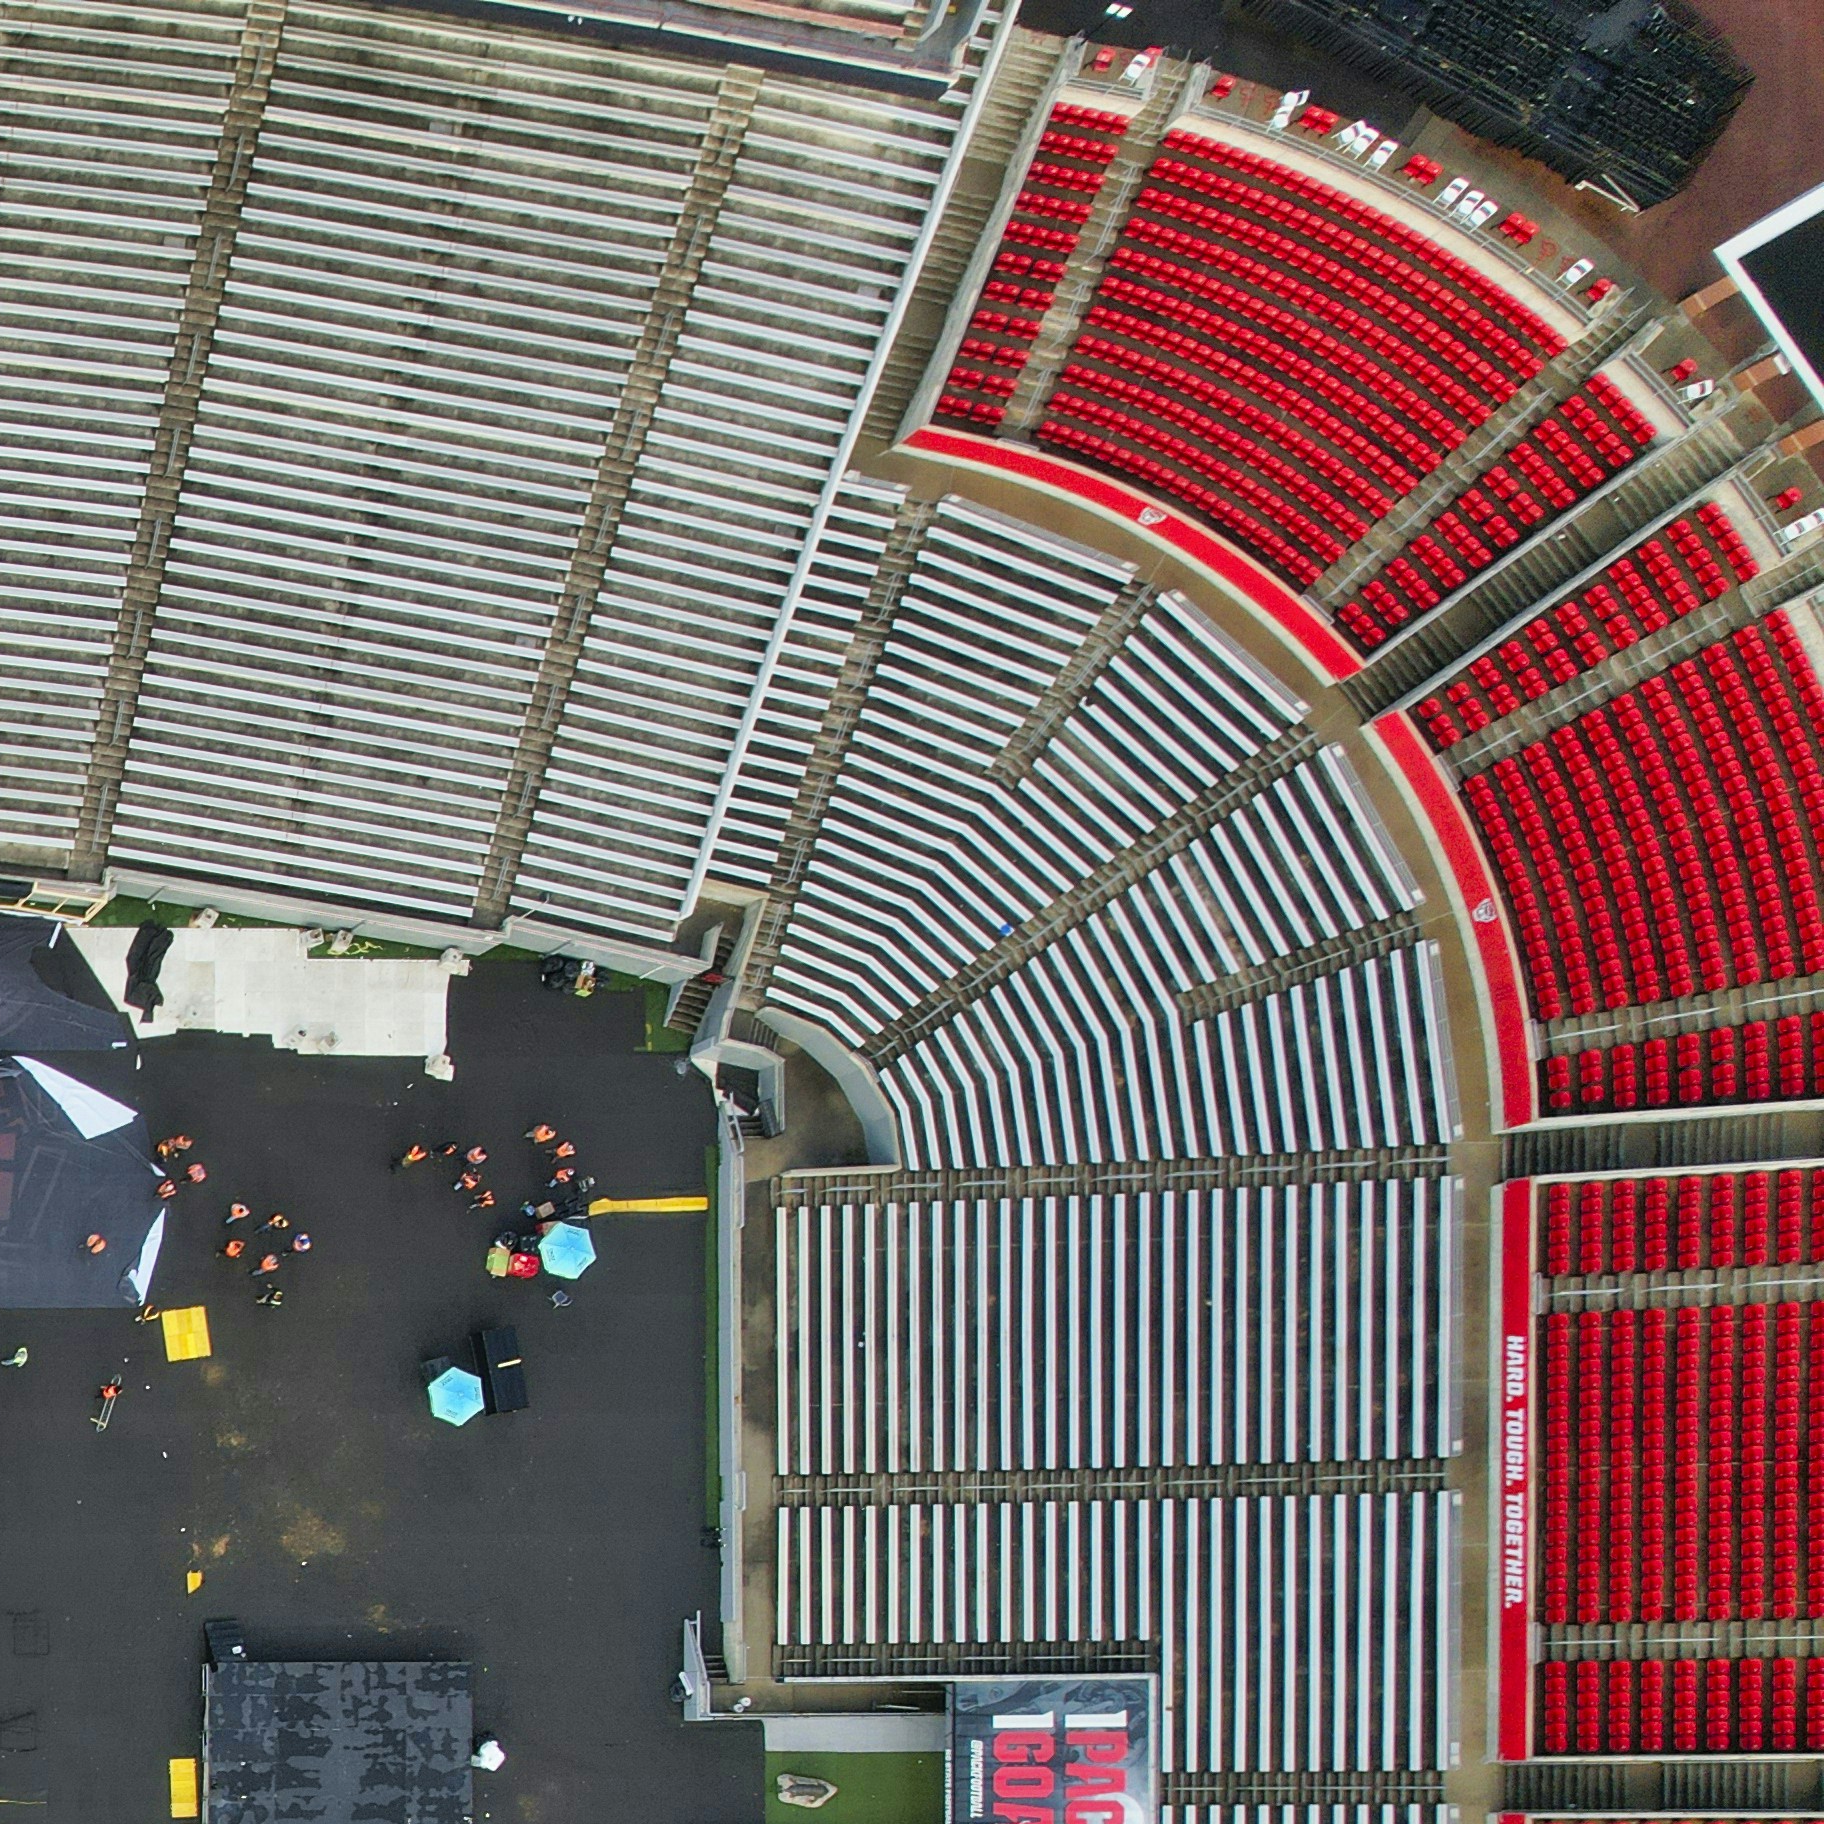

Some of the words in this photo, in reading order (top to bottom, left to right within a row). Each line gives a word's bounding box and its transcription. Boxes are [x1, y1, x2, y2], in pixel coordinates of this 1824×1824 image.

[1506, 1335, 1527, 1402] HARD.
[1505, 1408, 1527, 1488] TOUGH.
[1504, 1492, 1525, 1609] TOGETHER.
[970, 1739, 984, 1818] @PACKFOOTBALL
